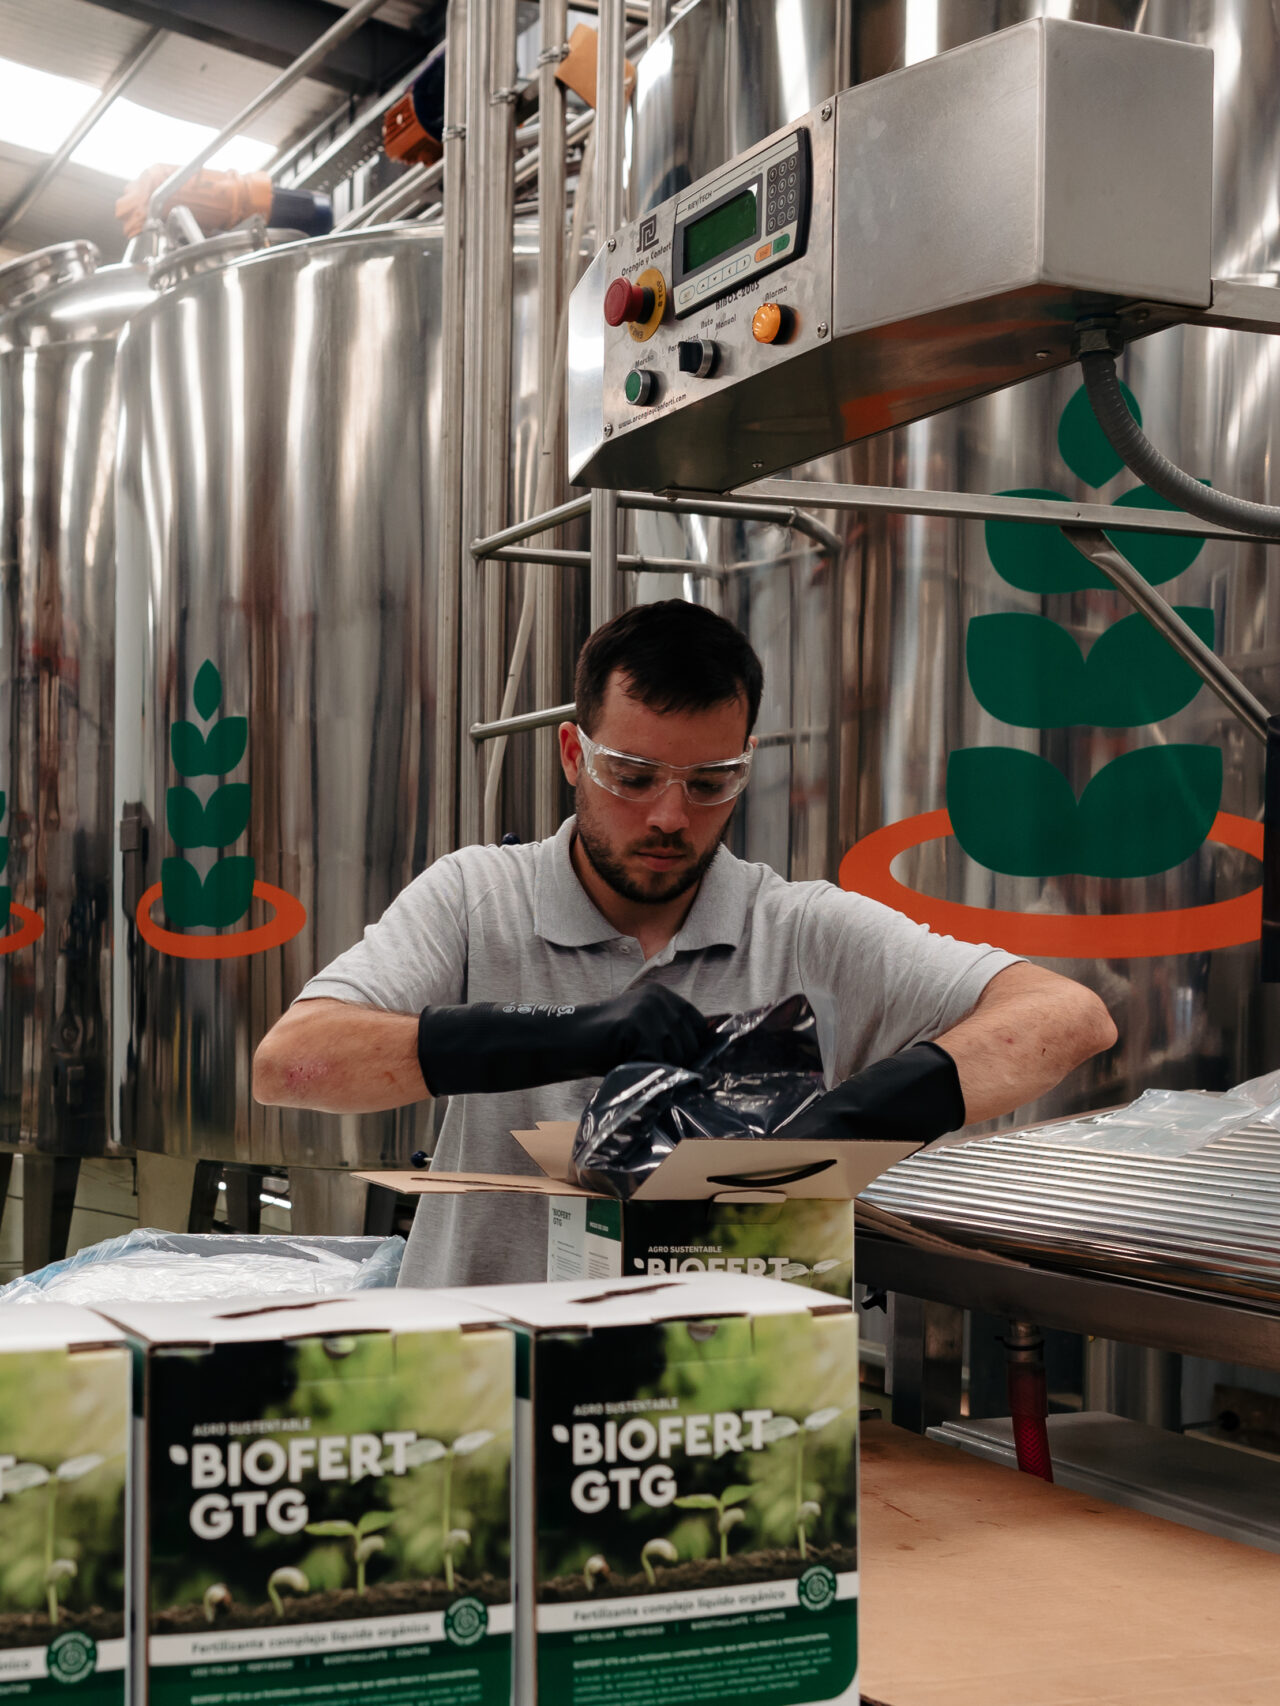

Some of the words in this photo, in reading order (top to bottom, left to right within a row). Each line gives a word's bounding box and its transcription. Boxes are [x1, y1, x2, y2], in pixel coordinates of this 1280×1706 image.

[765, 285, 788, 301] Alarma
[700, 318, 713, 329] Auto
[670, 1245, 722, 1253] SUSTENTABLE
[572, 1402, 603, 1416] AGRO
[605, 1398, 679, 1415] SUSTENTABLE
[192, 1422, 226, 1437] AGRO
[572, 1409, 773, 1466] BIOFERT
[191, 1431, 417, 1489] BIOFERT
[571, 1464, 678, 1514] GTG
[189, 1488, 309, 1540] GTG
